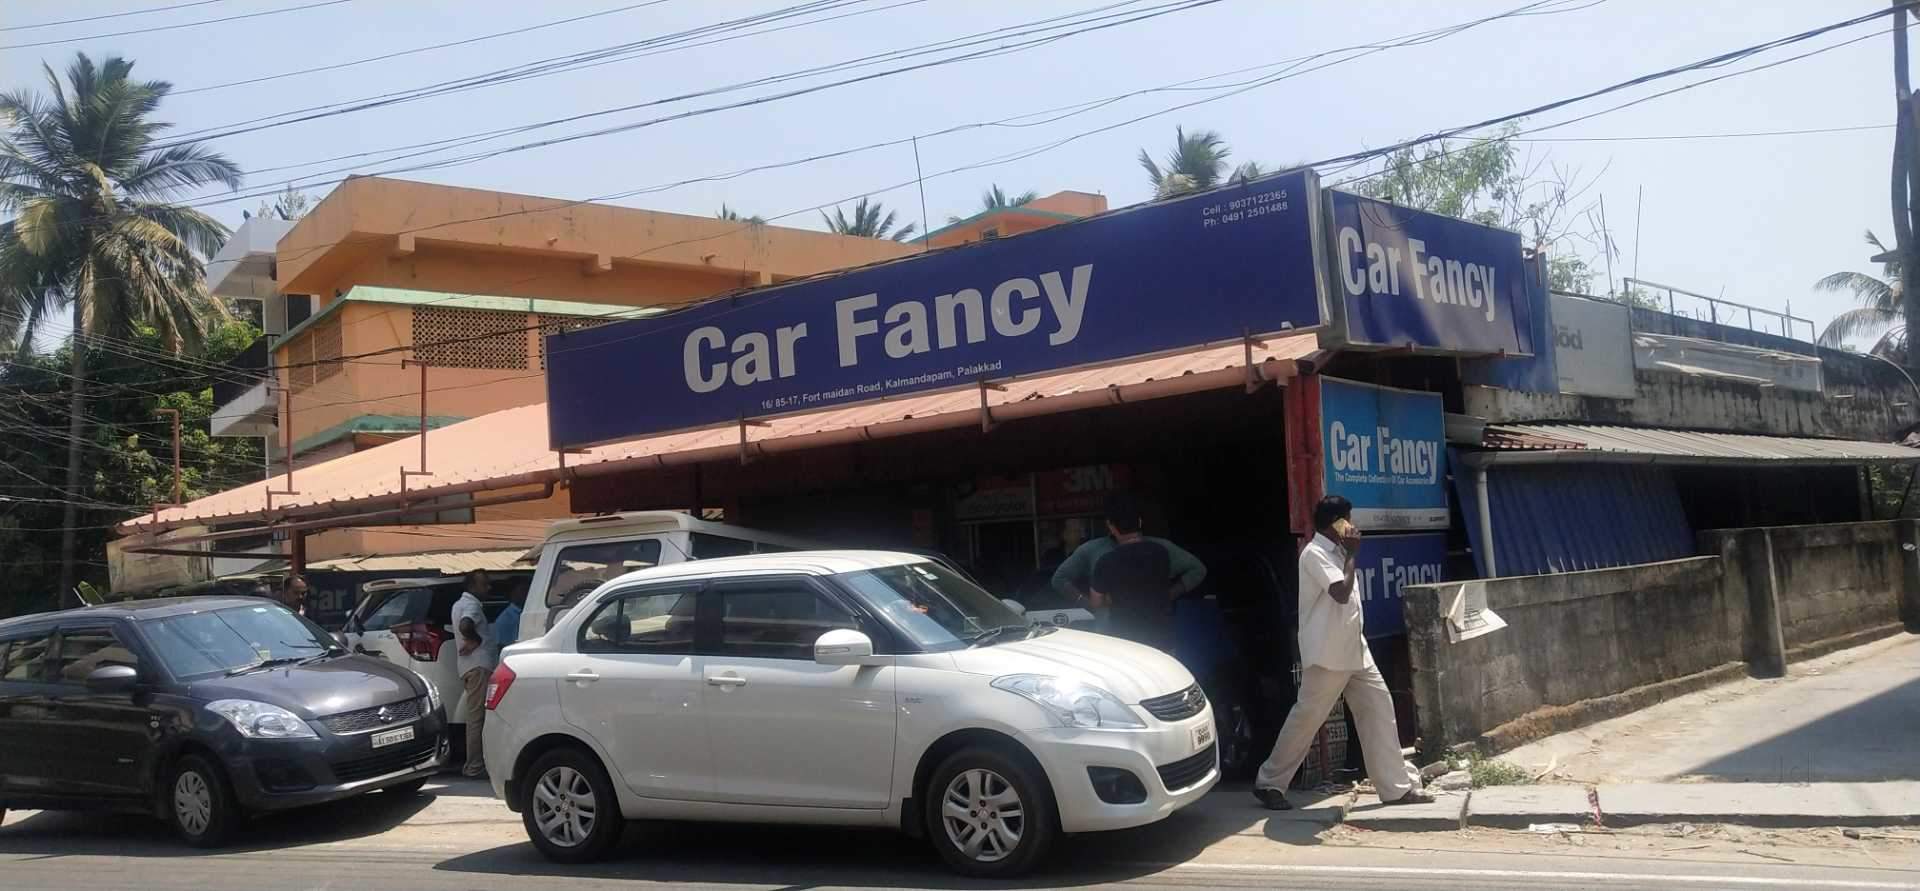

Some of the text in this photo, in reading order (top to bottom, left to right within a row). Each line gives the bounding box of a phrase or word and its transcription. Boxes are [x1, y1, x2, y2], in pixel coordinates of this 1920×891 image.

[1202, 205, 1221, 216] Cell
[1222, 211, 1244, 223] 0491
[1339, 226, 1496, 322] Car Fancy
[684, 264, 1094, 393] Car Fancy
[803, 392, 821, 403] Fort
[822, 386, 854, 401] maidan
[856, 382, 883, 395] Road,
[957, 360, 1002, 377] Palakkad
[1330, 420, 1438, 485] Car Fancy
[1063, 464, 1113, 493] 3M
[1354, 567, 1376, 601] ar
